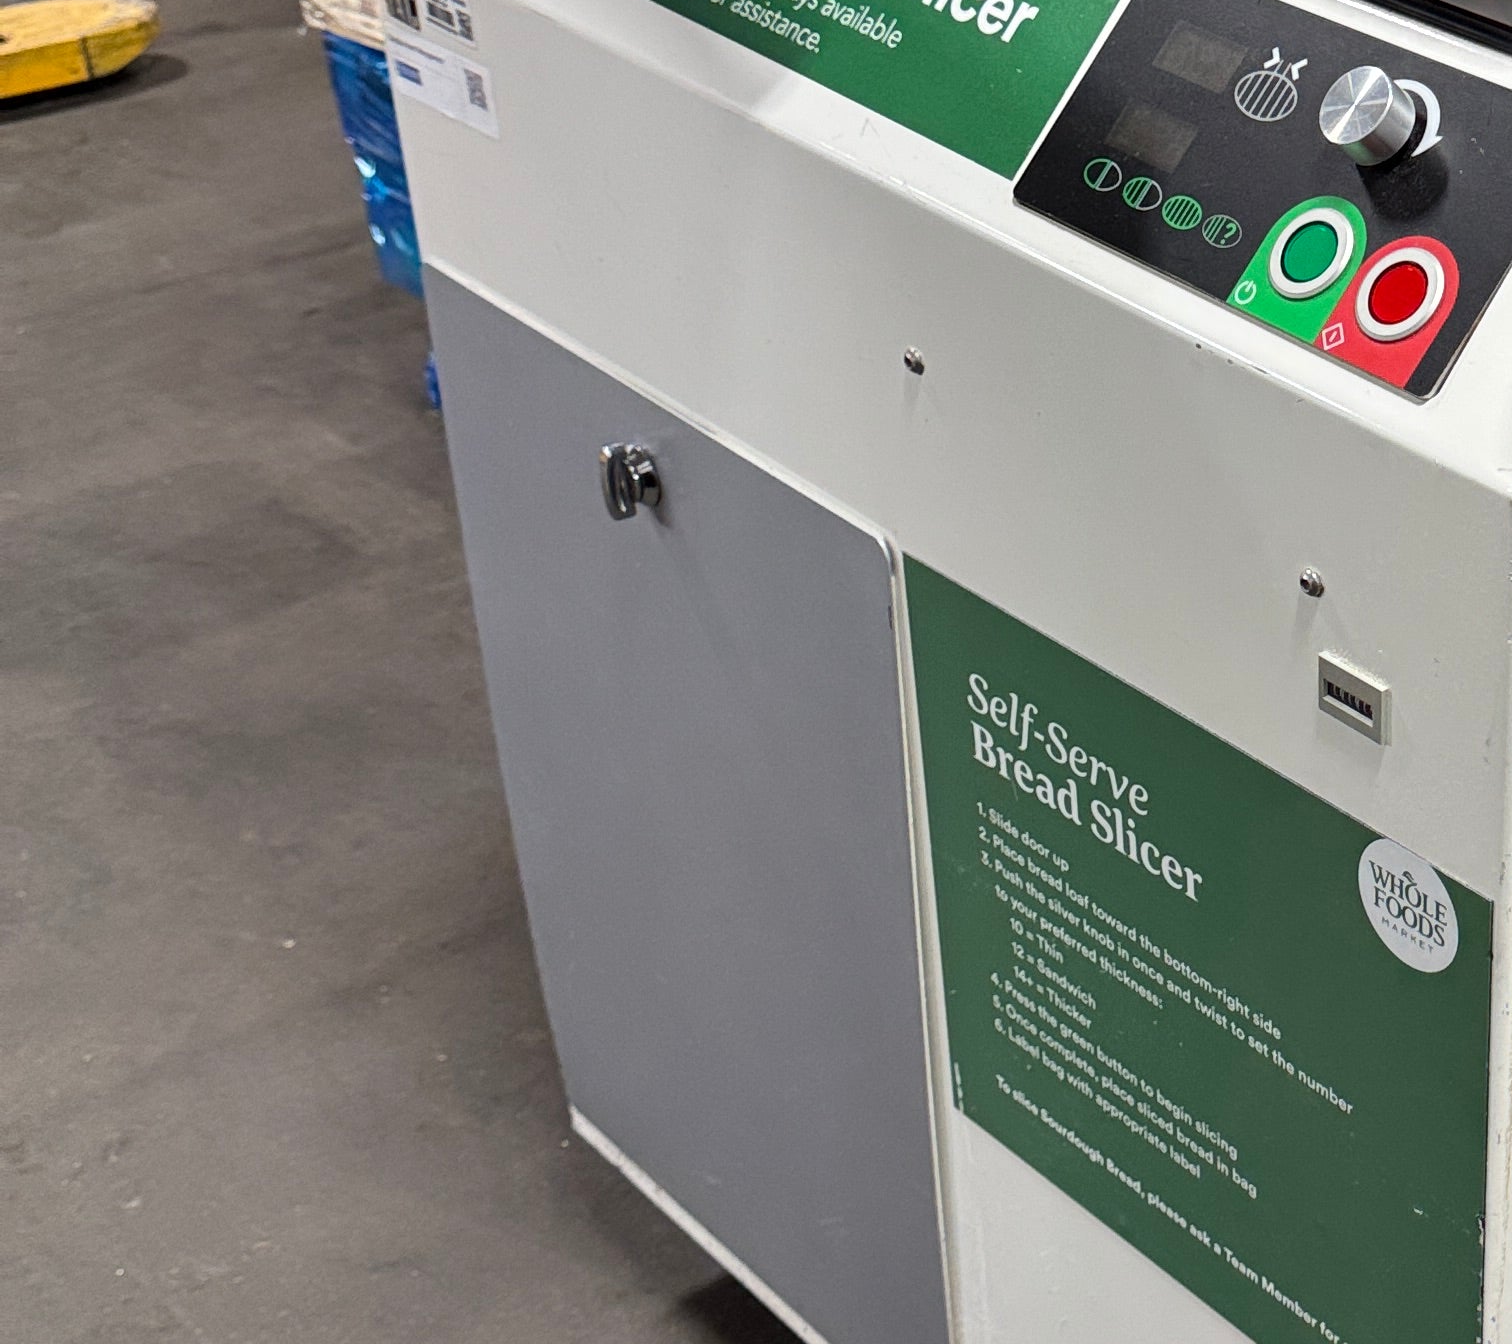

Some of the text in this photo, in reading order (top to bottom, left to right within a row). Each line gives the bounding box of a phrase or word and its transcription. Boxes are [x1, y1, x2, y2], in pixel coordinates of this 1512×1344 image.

[967, 674, 1148, 821] Self-Serve
[971, 721, 1202, 901] Bread Slicer
[975, 801, 1070, 873] 1. Slide door up
[1369, 860, 1448, 927] WHOLE
[977, 825, 1282, 1040] 2. Place bread loaf toward the bottom-right side
[980, 849, 1353, 1115] 3. Push the silver knob in once and twist to set the number
[993, 883, 1163, 1010] to your preferred thickness:
[1008, 916, 1024, 936] 10
[1035, 933, 1064, 964] Thin
[1010, 941, 1025, 960] 12
[1036, 957, 1097, 1010] Sandwich
[1373, 886, 1445, 947] FOODS
[1381, 917, 1434, 954] MARKET
[989, 971, 1238, 1161] 4. Press the green button to begin slicing
[1045, 986, 1092, 1029] Thicker
[991, 993, 1258, 1200] 5. Once complete, place sliced bread in bag
[993, 1017, 1201, 1179] 6. Label bag with appropriate label
[994, 1073, 1011, 1095] To
[1011, 1089, 1039, 1116] slice
[1039, 1108, 1105, 1166] Sourdough
[1105, 1157, 1146, 1200] Bread,
[1146, 1191, 1188, 1229] please
[1188, 1223, 1212, 1248] ask
[1212, 1242, 1222, 1256] a
[1222, 1246, 1259, 1285] Team
[1260, 1275, 1318, 1328] Member
[1318, 1321, 1341, 1344] for
